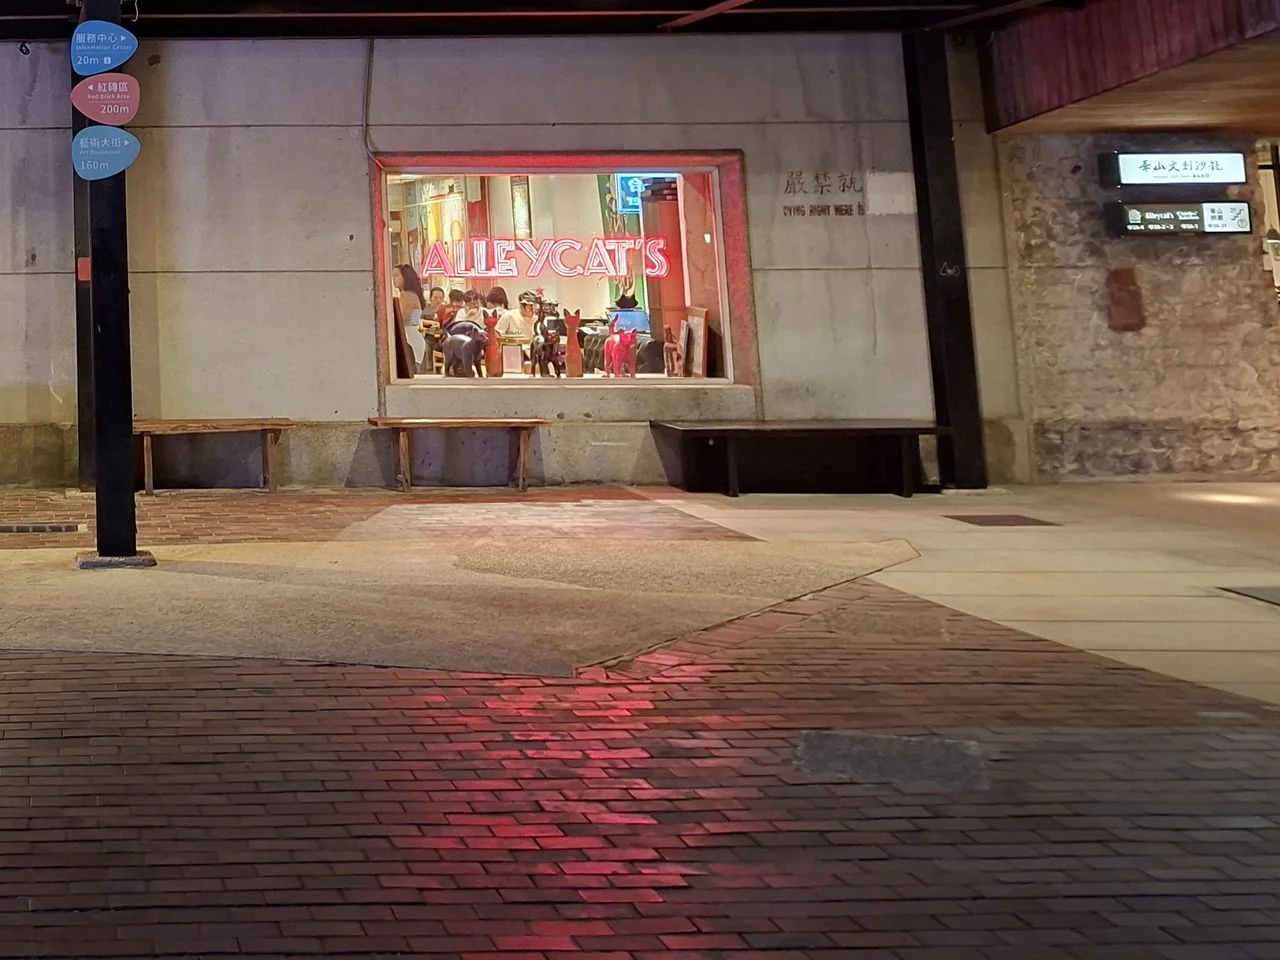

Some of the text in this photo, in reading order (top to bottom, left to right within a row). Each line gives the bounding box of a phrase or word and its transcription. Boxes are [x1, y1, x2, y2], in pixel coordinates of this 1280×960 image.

[76, 33, 117, 43] 服務中心
[77, 56, 99, 65] 20m
[97, 82, 129, 93] 紅磚區
[100, 104, 129, 114] 200m
[80, 138, 121, 148] 藝術大街
[81, 160, 109, 170] 160m
[421, 237, 669, 278] ALLEYCAT'S
